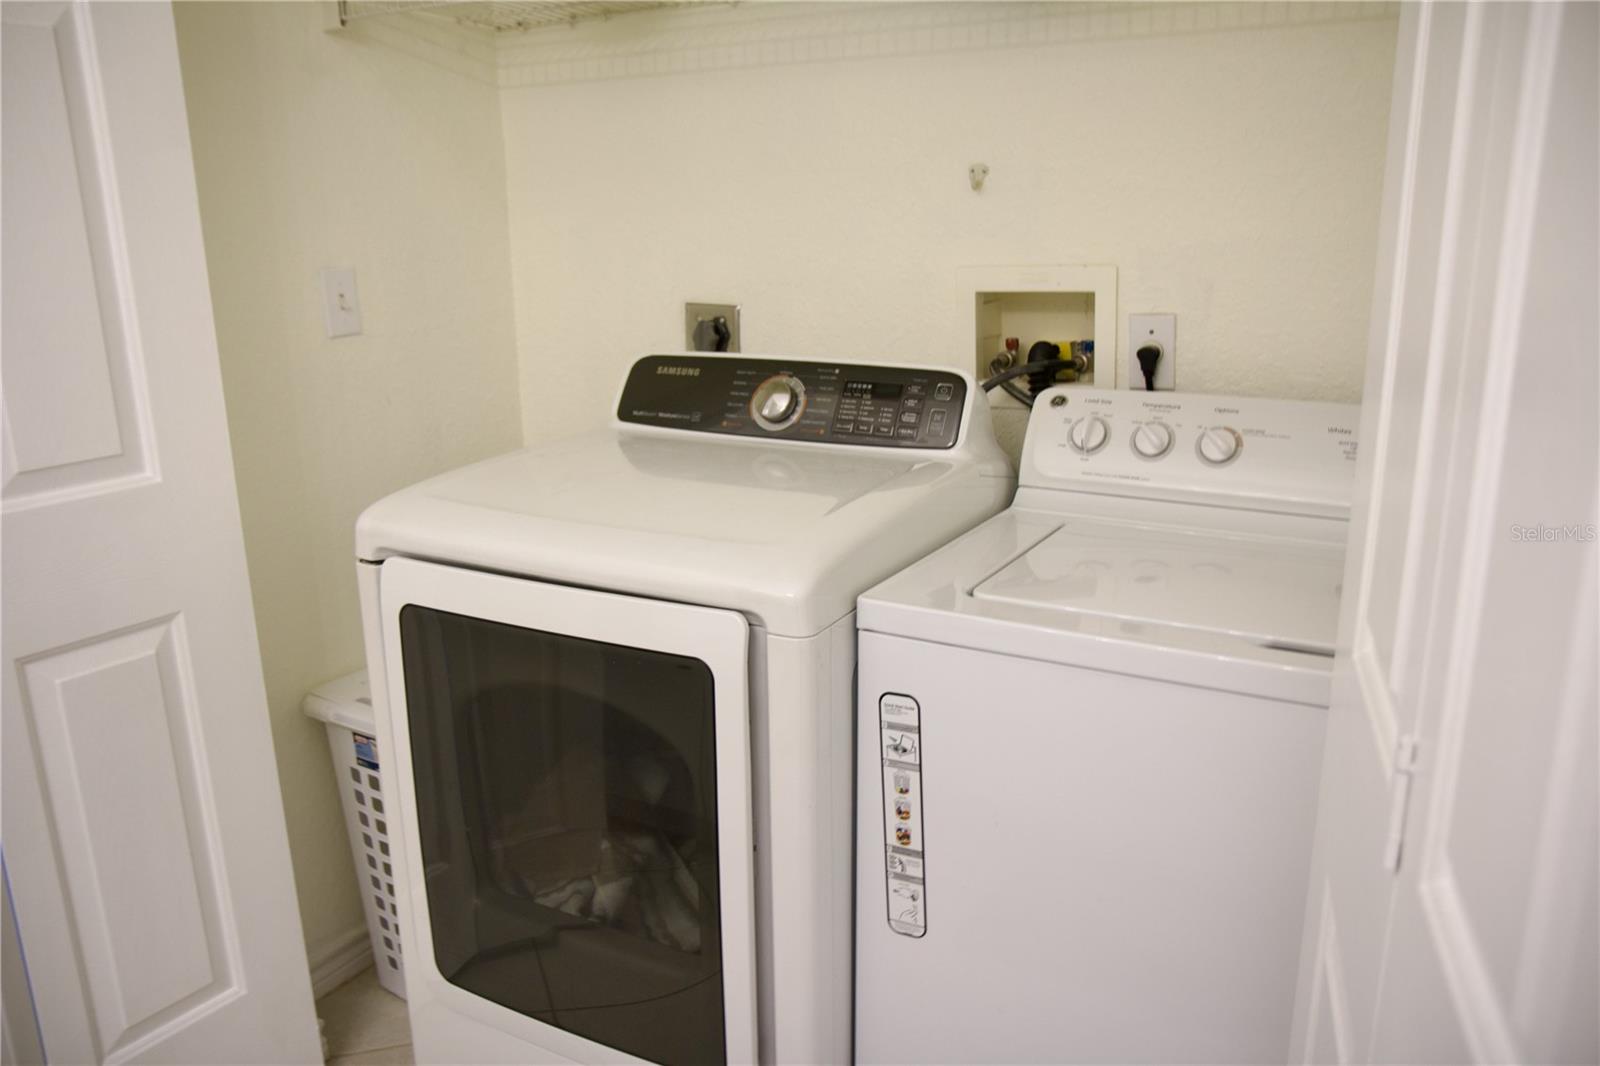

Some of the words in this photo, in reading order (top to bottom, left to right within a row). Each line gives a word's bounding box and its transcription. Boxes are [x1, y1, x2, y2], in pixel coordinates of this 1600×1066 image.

[656, 366, 701, 377] SAMSUNG
[1084, 397, 1098, 405] Load
[1142, 401, 1182, 411] Temperature
[1214, 407, 1240, 416] Options
